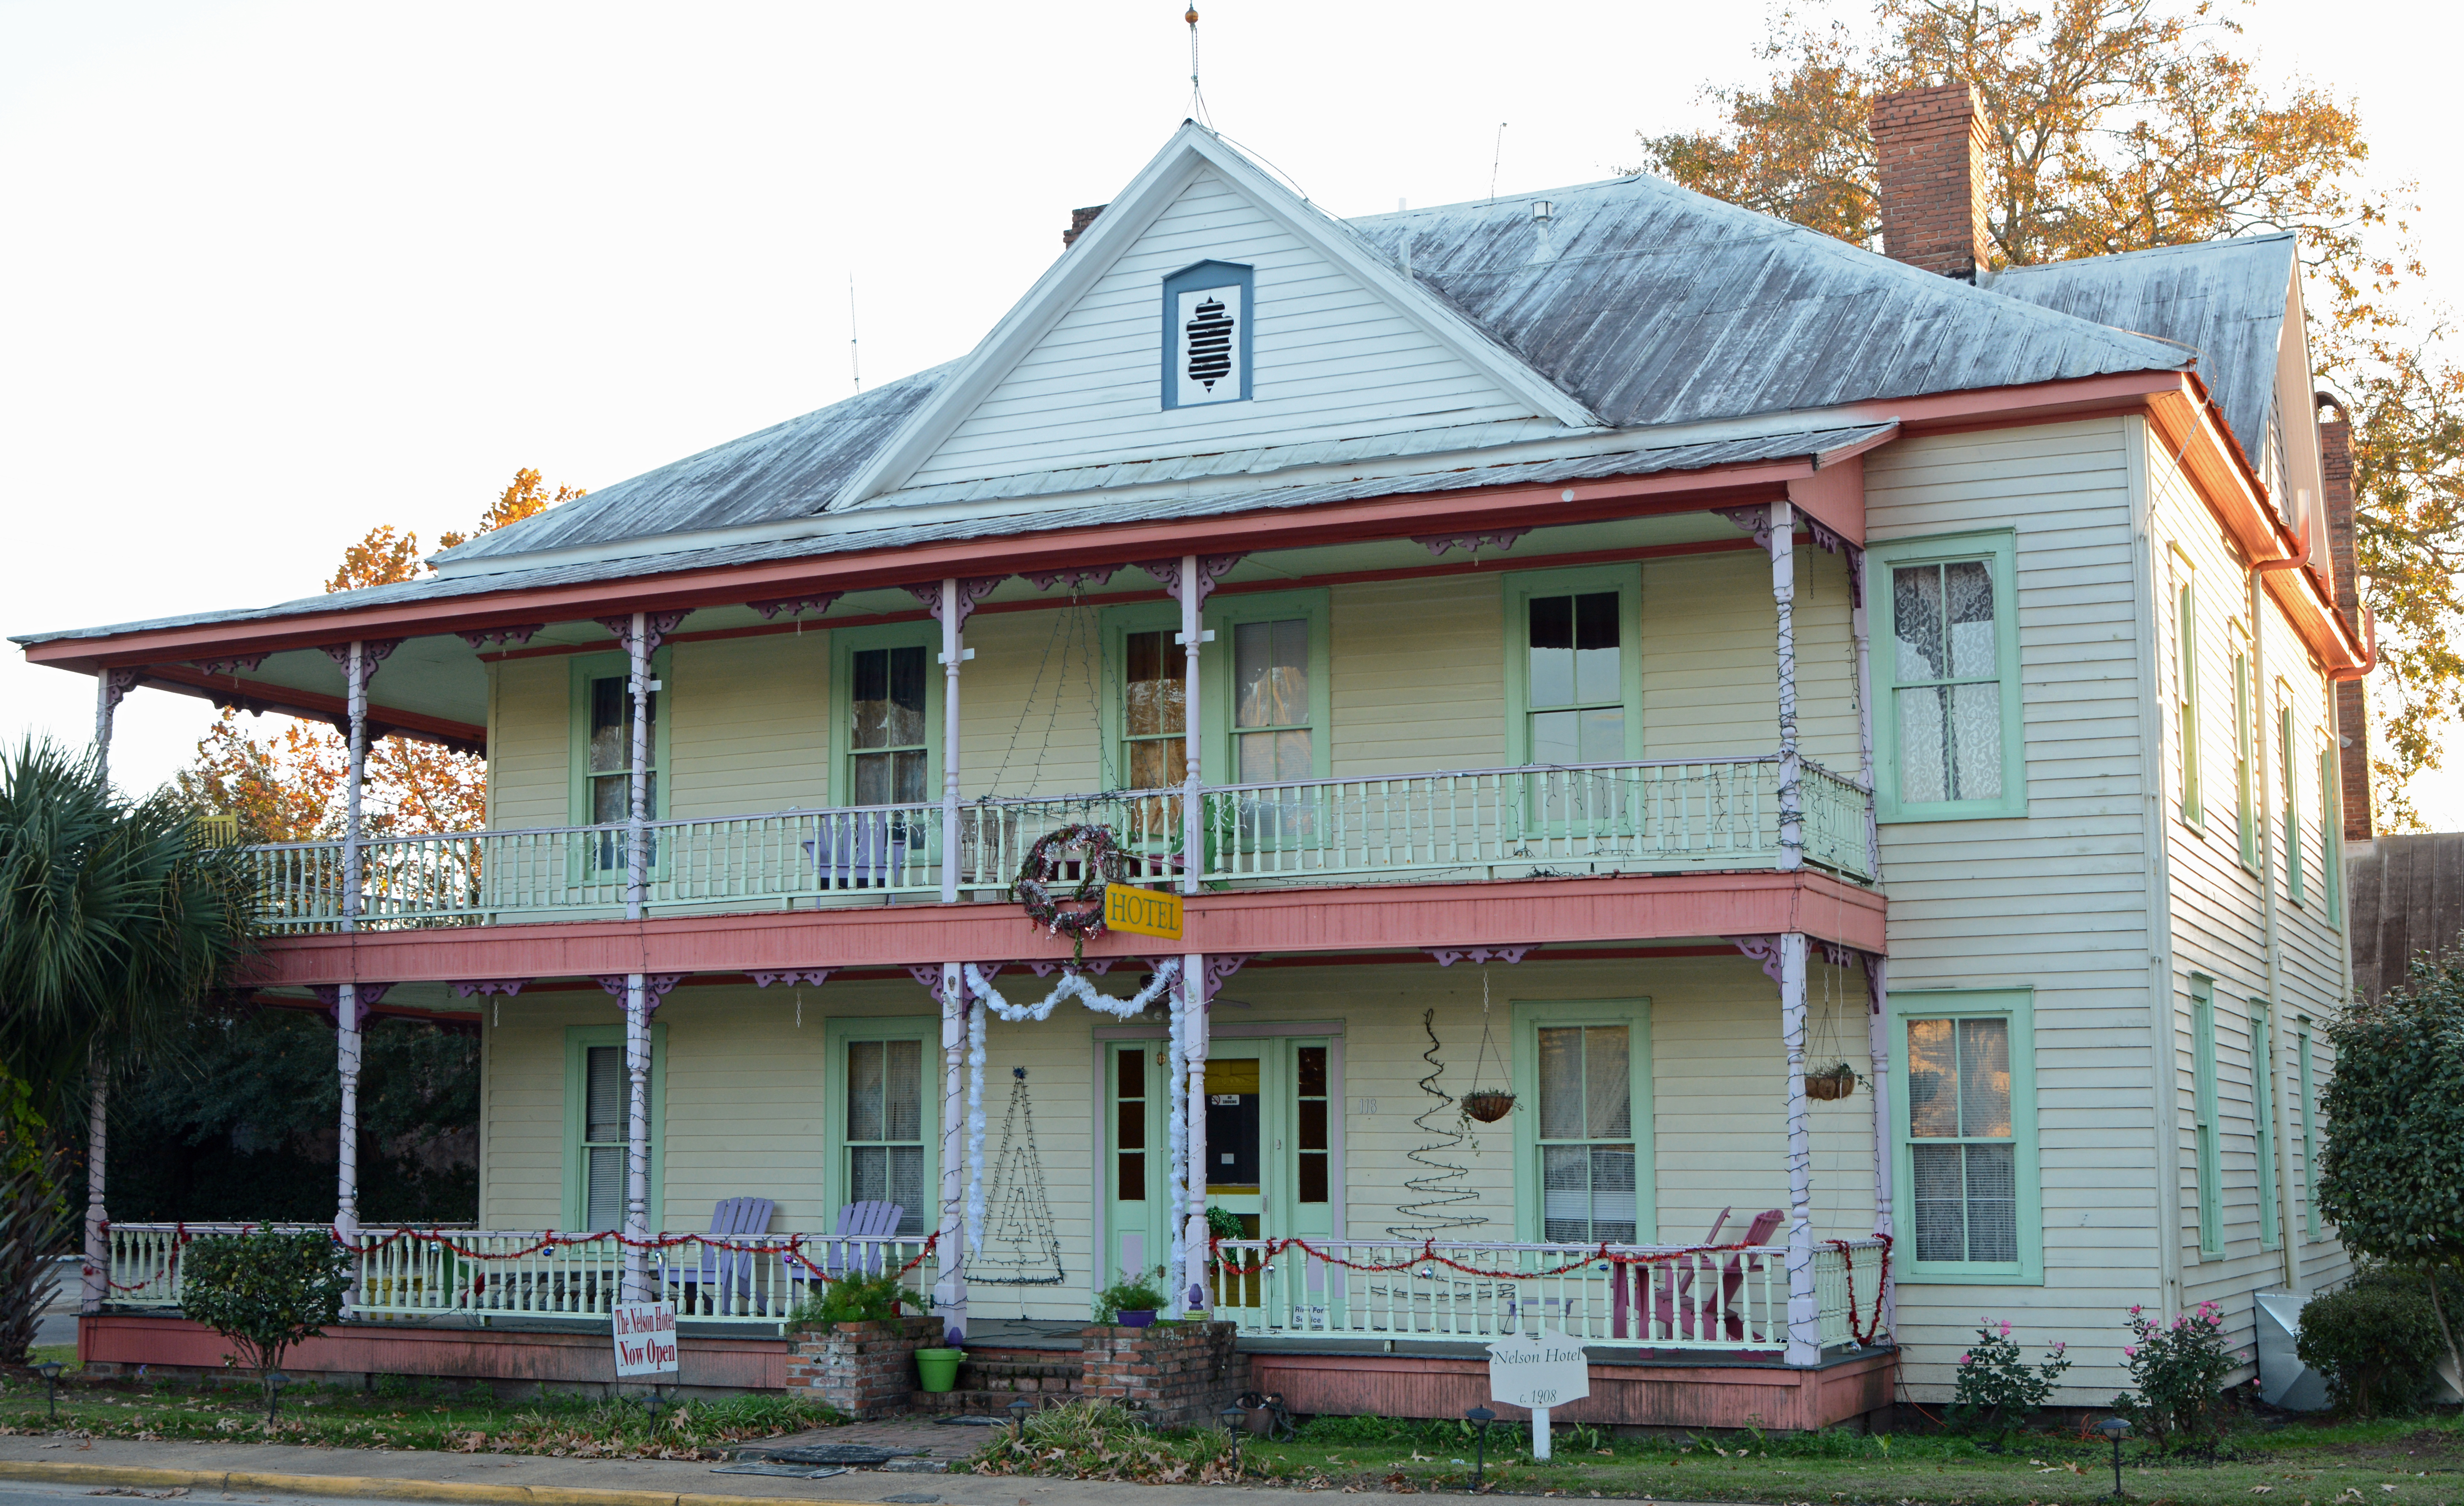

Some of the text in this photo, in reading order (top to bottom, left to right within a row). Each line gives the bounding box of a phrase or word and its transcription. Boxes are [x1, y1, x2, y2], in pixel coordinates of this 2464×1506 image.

[1110, 892, 1179, 931] HOTEL
[1360, 1098, 1377, 1114] 118
[615, 1305, 675, 1335] The Nelson Hotel
[619, 1338, 675, 1370] Now Open
[1494, 1347, 1581, 1364] Nelson Hotel
[1520, 1390, 1557, 1403] c. 1908
